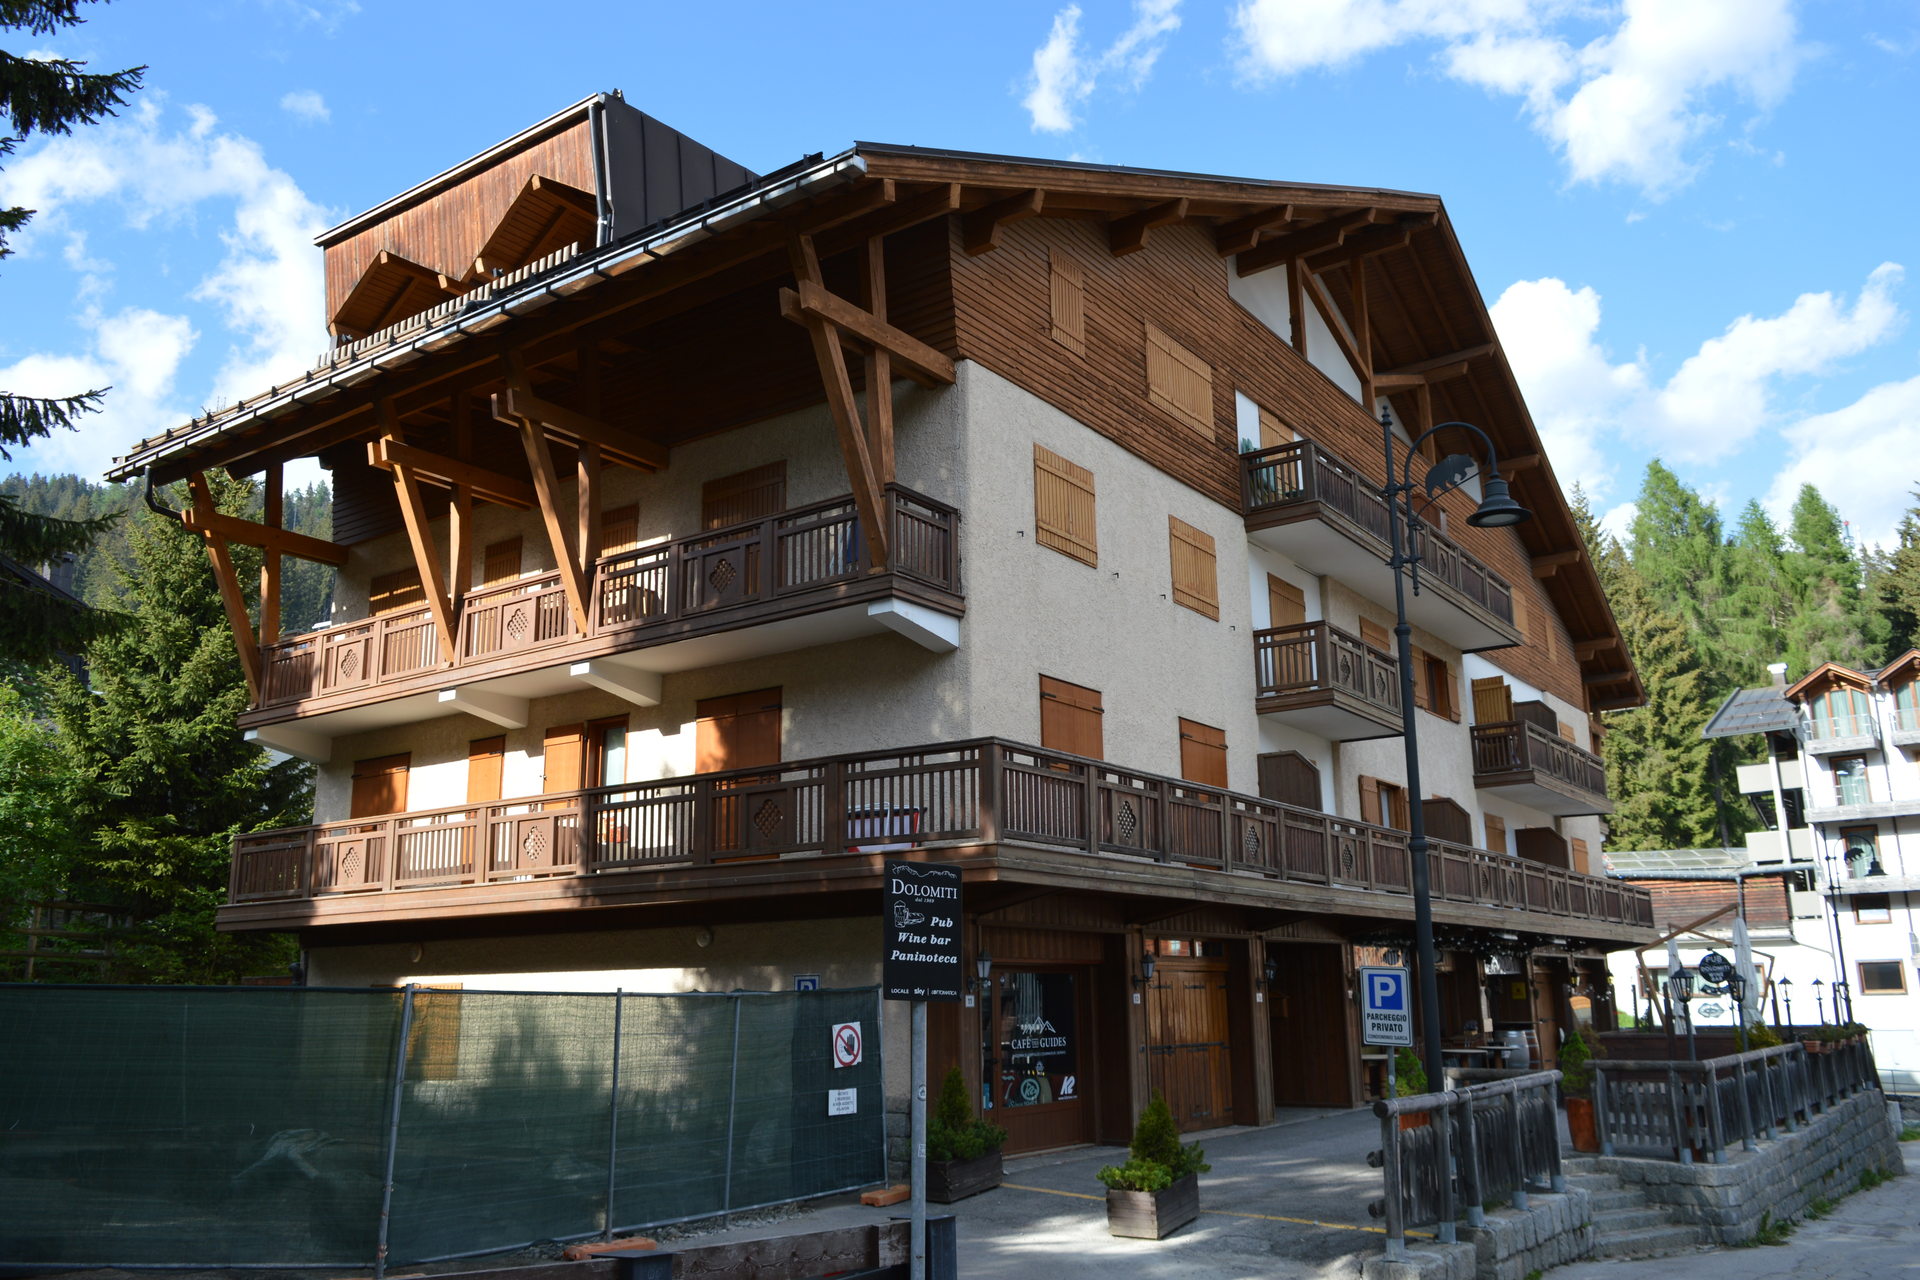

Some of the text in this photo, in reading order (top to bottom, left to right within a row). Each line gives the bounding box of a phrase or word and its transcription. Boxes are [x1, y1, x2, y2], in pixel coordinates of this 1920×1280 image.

[892, 879, 957, 899] DOLOMITI
[930, 916, 953, 928] Pub
[898, 932, 951, 945] Wine bar
[890, 950, 958, 964] Paninoteca
[914, 988, 925, 996] sky
[1373, 976, 1397, 1007] P
[1367, 1013, 1407, 1022] PARCHEGGIO
[1372, 1023, 1403, 1032] PRIVATO
[1011, 1036, 1031, 1050] CAFÉ
[1040, 1037, 1067, 1048] GUIDES
[1060, 1075, 1075, 1095] K2
